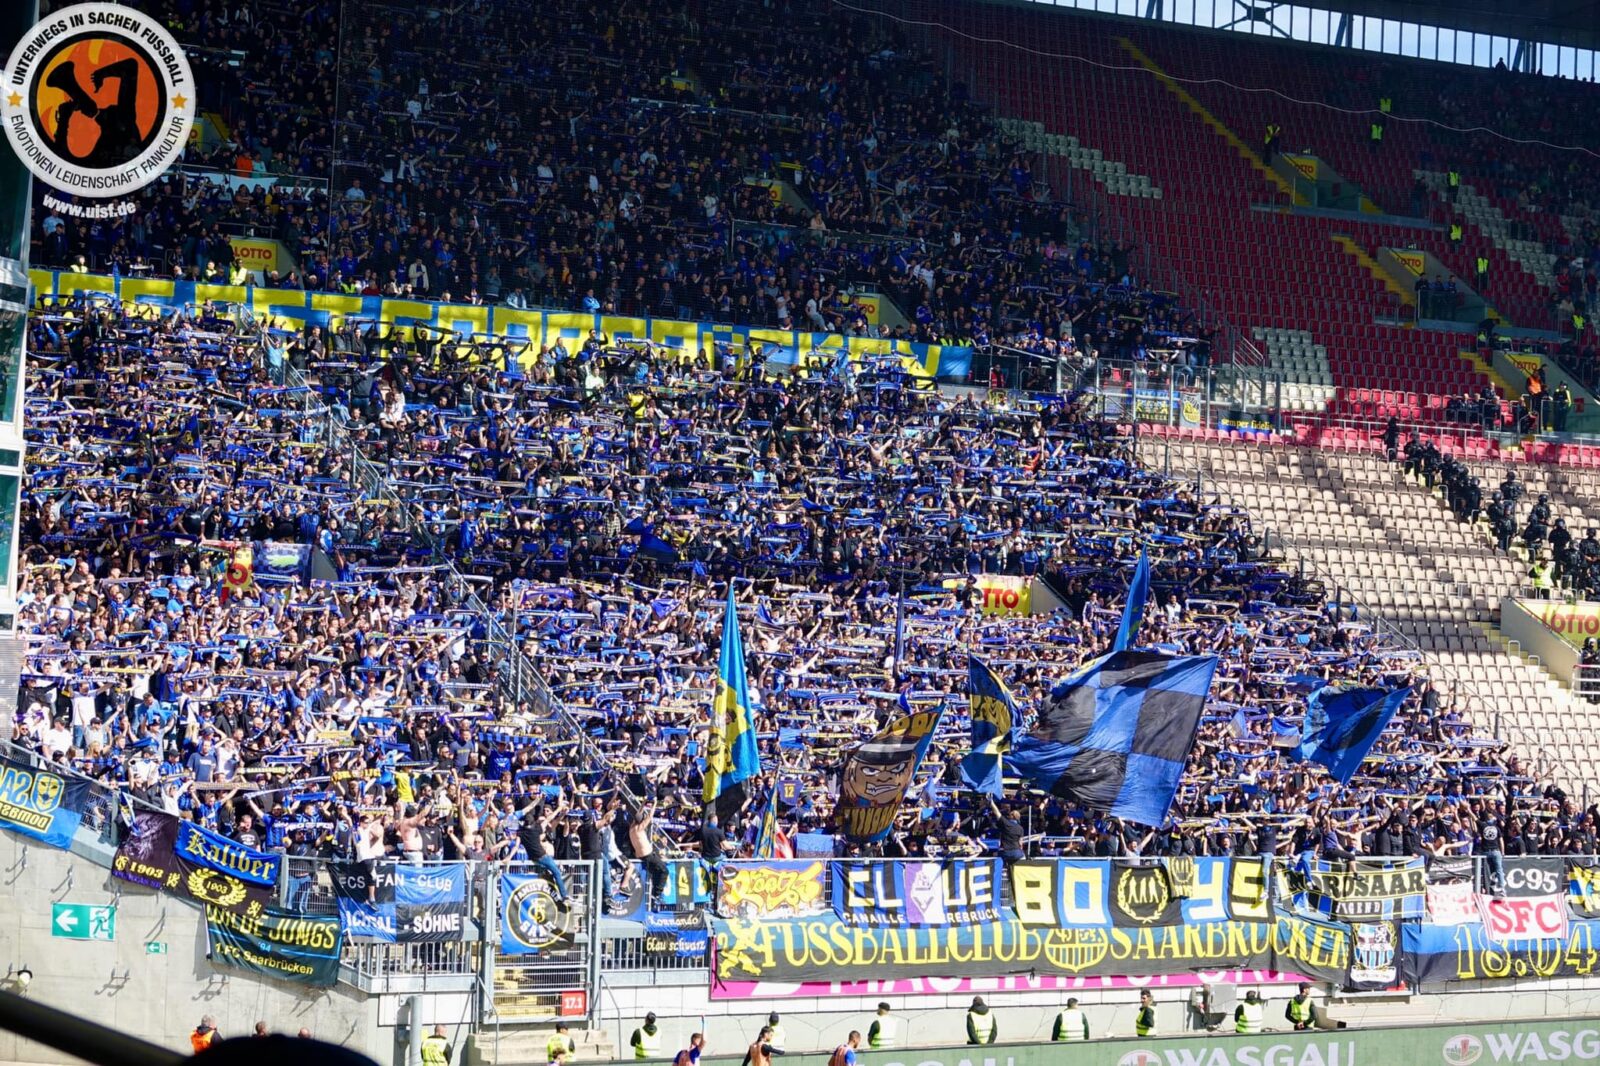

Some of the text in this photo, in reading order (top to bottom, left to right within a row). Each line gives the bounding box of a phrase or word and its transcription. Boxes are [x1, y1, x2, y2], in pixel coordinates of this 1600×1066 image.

[233, 246, 272, 260] LOTTO
[983, 588, 1019, 608] TTO
[184, 828, 275, 880] Kaliber
[130, 861, 164, 879] 1903
[206, 880, 228, 894] 1903
[339, 875, 366, 889] FCS
[376, 873, 404, 888] FAN
[843, 911, 906, 924] CANAILLE
[1488, 900, 1561, 934] SFC
[268, 918, 338, 949] JUNGS
[243, 950, 314, 975] Saarbrücken
[565, 997, 582, 1009] 17.1
